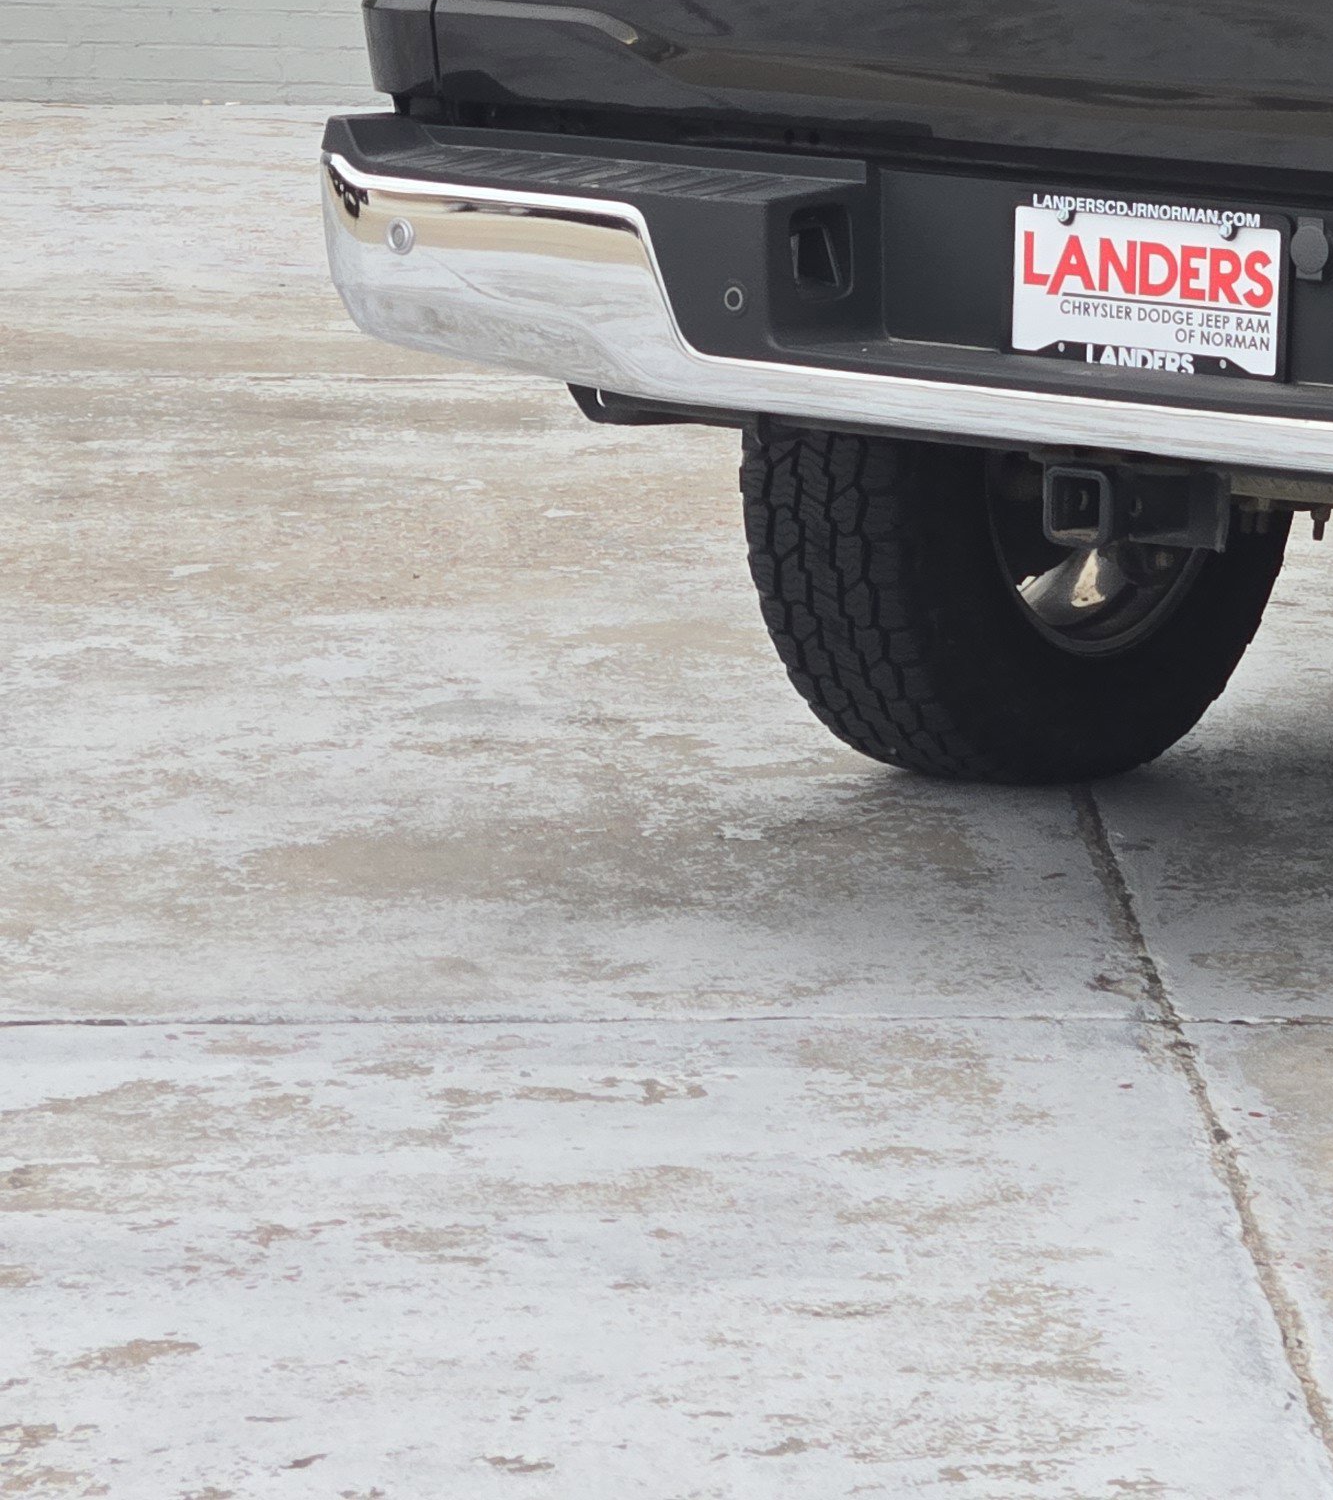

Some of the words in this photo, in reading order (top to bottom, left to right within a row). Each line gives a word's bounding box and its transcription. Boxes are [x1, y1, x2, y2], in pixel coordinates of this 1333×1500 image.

[1032, 193, 1261, 228] LANDERSCDJRNORMAN.COM
[1023, 230, 1274, 309] LANDERS
[1059, 299, 1132, 321] CHRYSLER
[1137, 308, 1194, 327] DODGE
[1198, 312, 1231, 329] JEEP
[1235, 316, 1271, 334] RAM
[1175, 327, 1196, 344] OF
[1200, 330, 1270, 351] NORMAN
[1086, 343, 1195, 374] LANDERS
